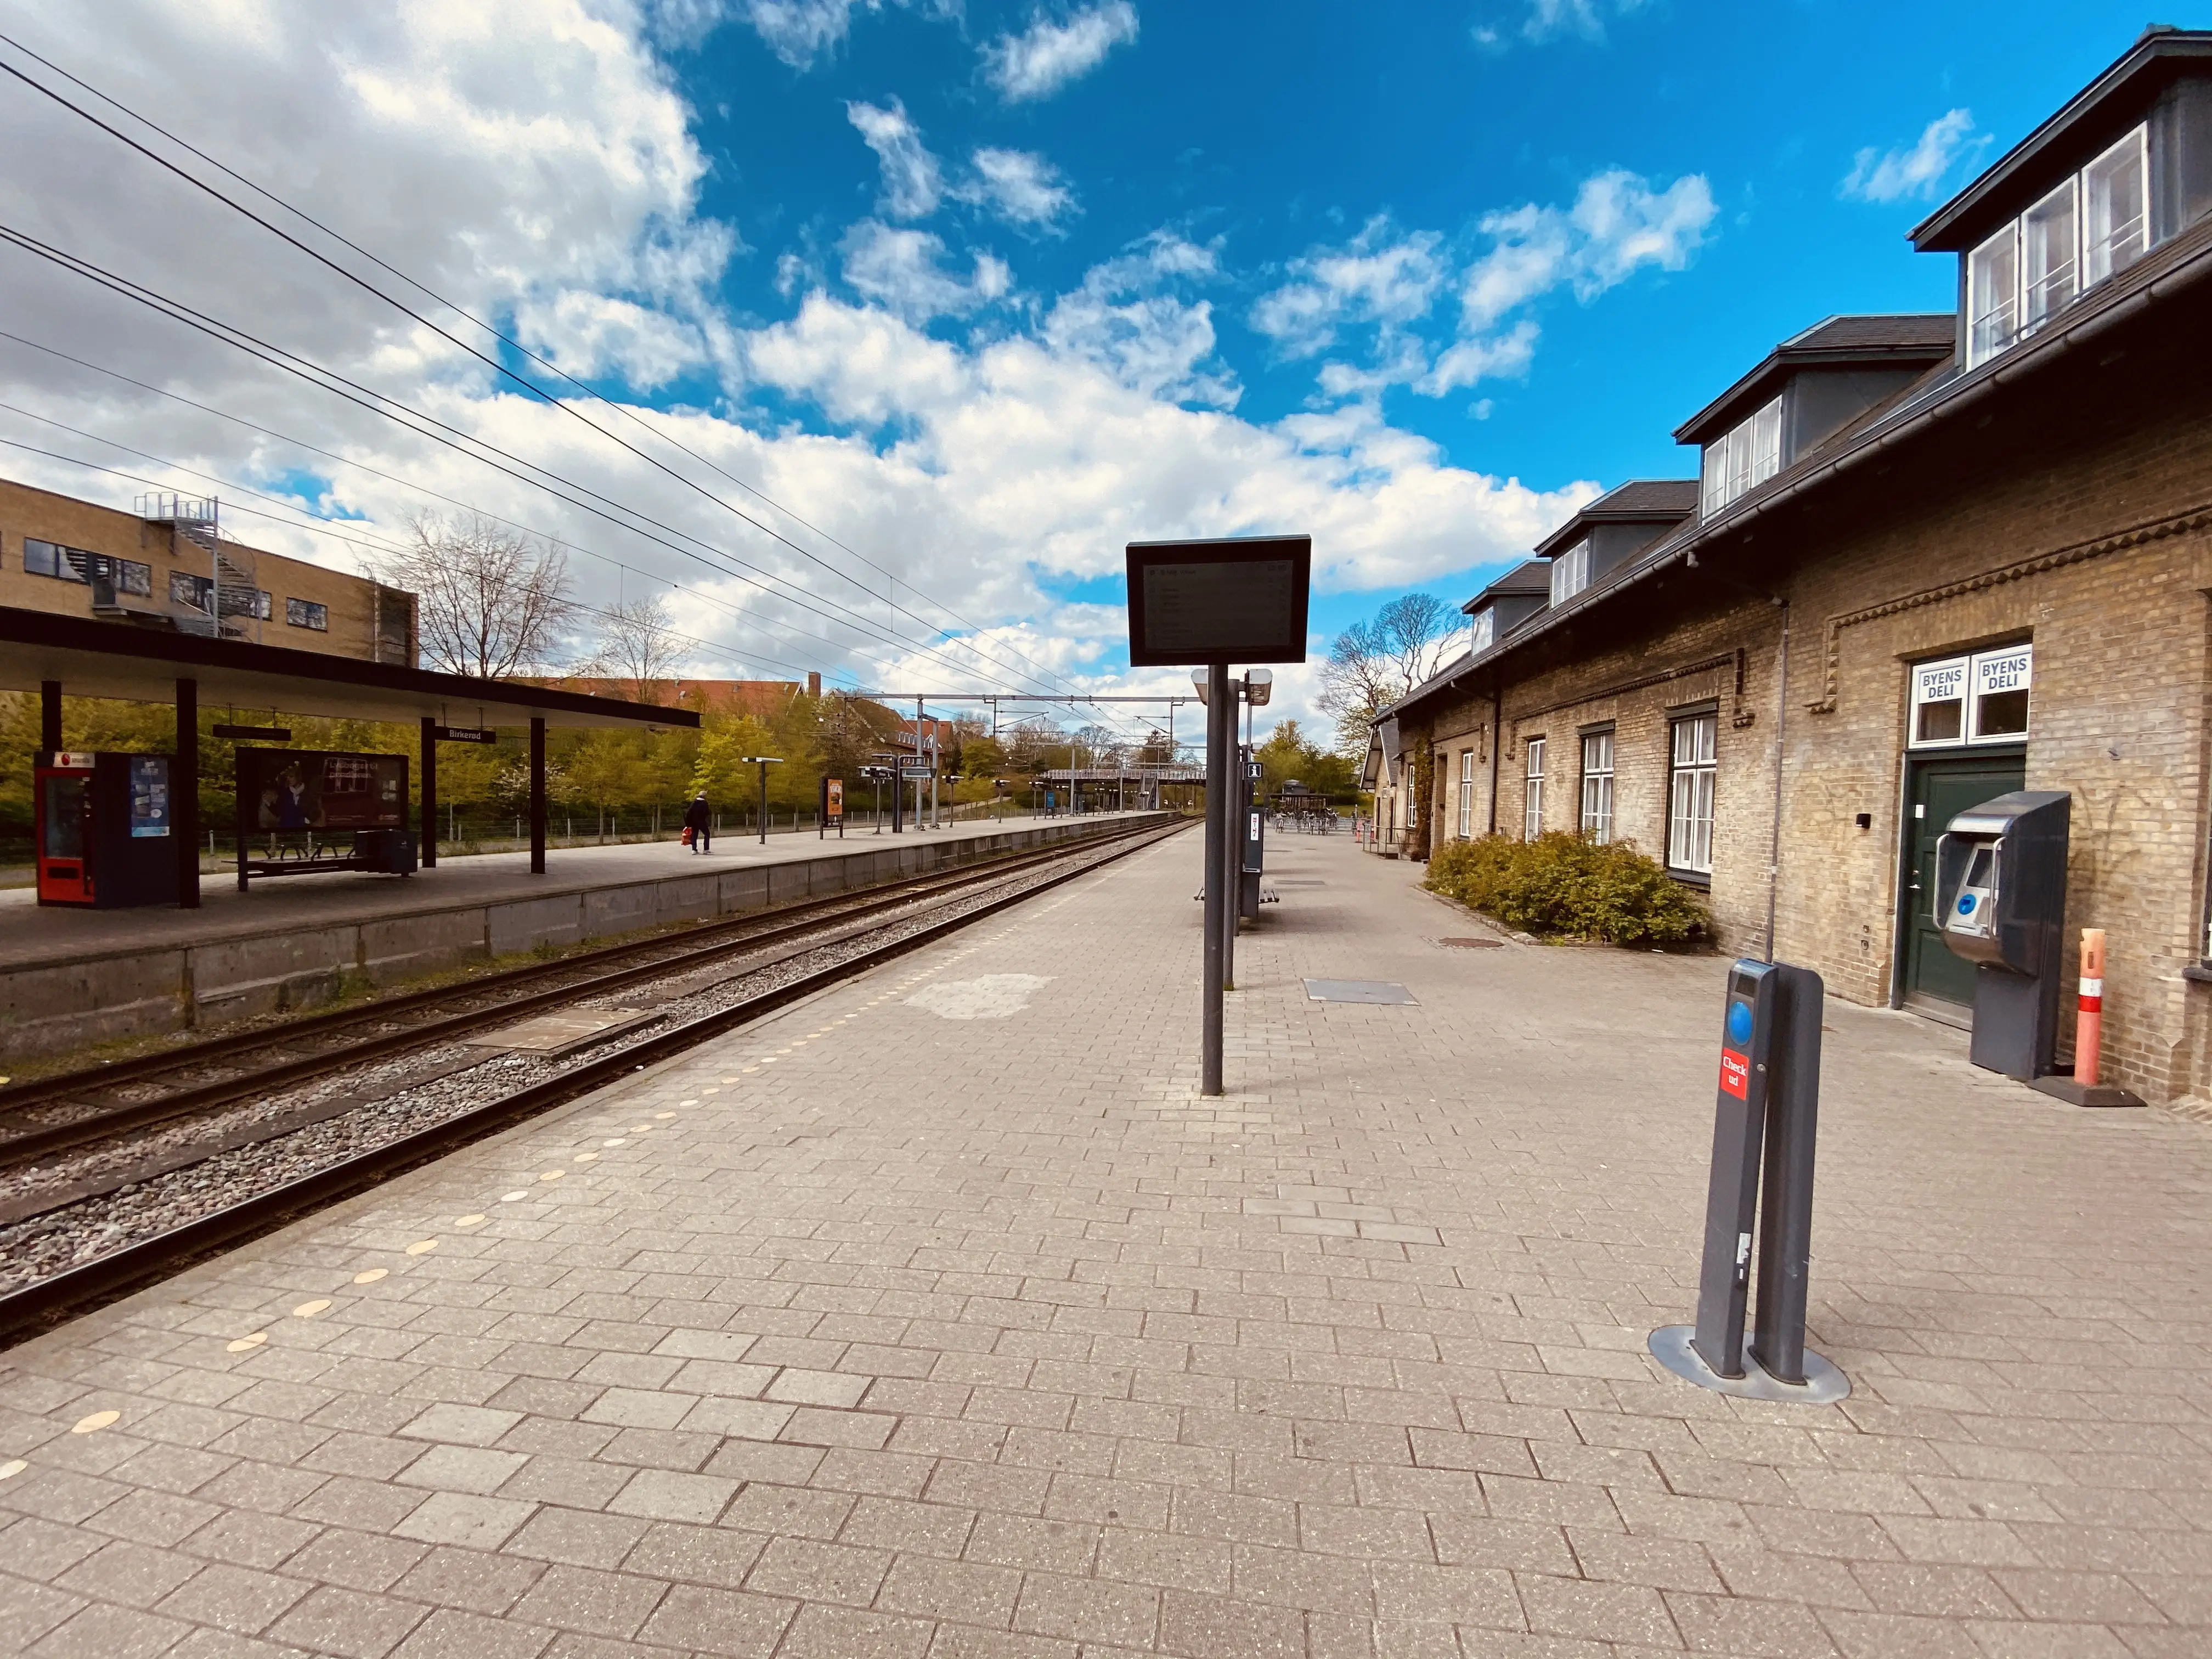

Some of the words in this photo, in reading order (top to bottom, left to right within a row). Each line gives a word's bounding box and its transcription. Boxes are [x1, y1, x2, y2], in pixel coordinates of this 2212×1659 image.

[1982, 658, 2027, 676] BYENS
[1923, 670, 1962, 686] BYENS
[1988, 674, 2018, 690] DELI
[1928, 684, 1954, 698] DELI
[449, 729, 481, 740] Birkerød
[1723, 1056, 1746, 1076] Check
[1728, 1075, 1739, 1086] ud
